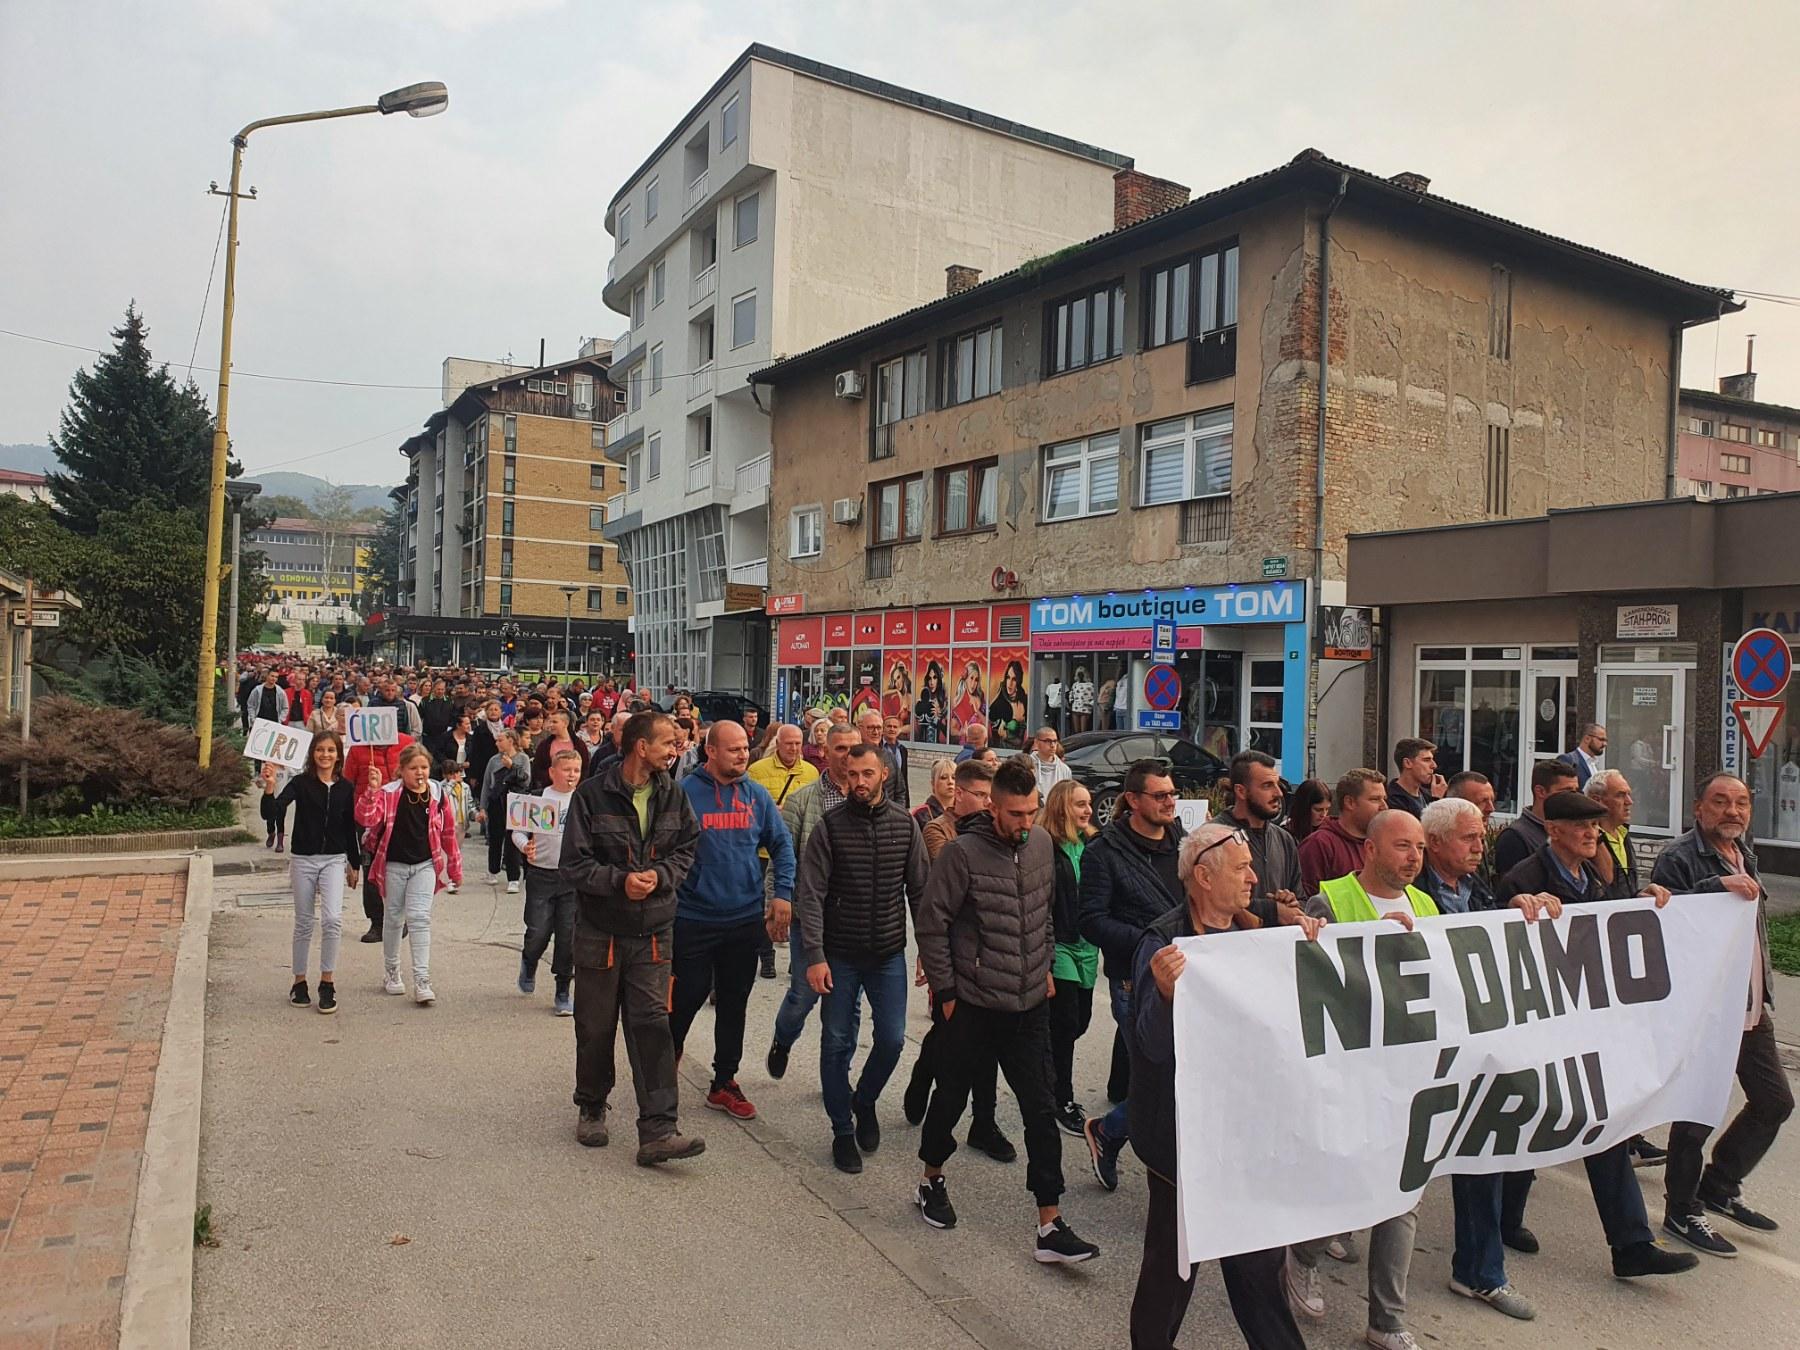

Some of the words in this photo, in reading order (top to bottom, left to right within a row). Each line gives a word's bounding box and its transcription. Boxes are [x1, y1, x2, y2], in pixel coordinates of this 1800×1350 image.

[1037, 602, 1093, 625] TOM
[1099, 596, 1206, 619] boutique
[1214, 589, 1293, 617] TOM
[1752, 612, 1800, 634] KA
[483, 629, 538, 638] FONANA
[349, 709, 393, 743] ĆIRO
[1295, 932, 1437, 1058] NE
[1446, 909, 1671, 1034] DAMO
[1399, 1047, 1609, 1193] ĆIRU!
